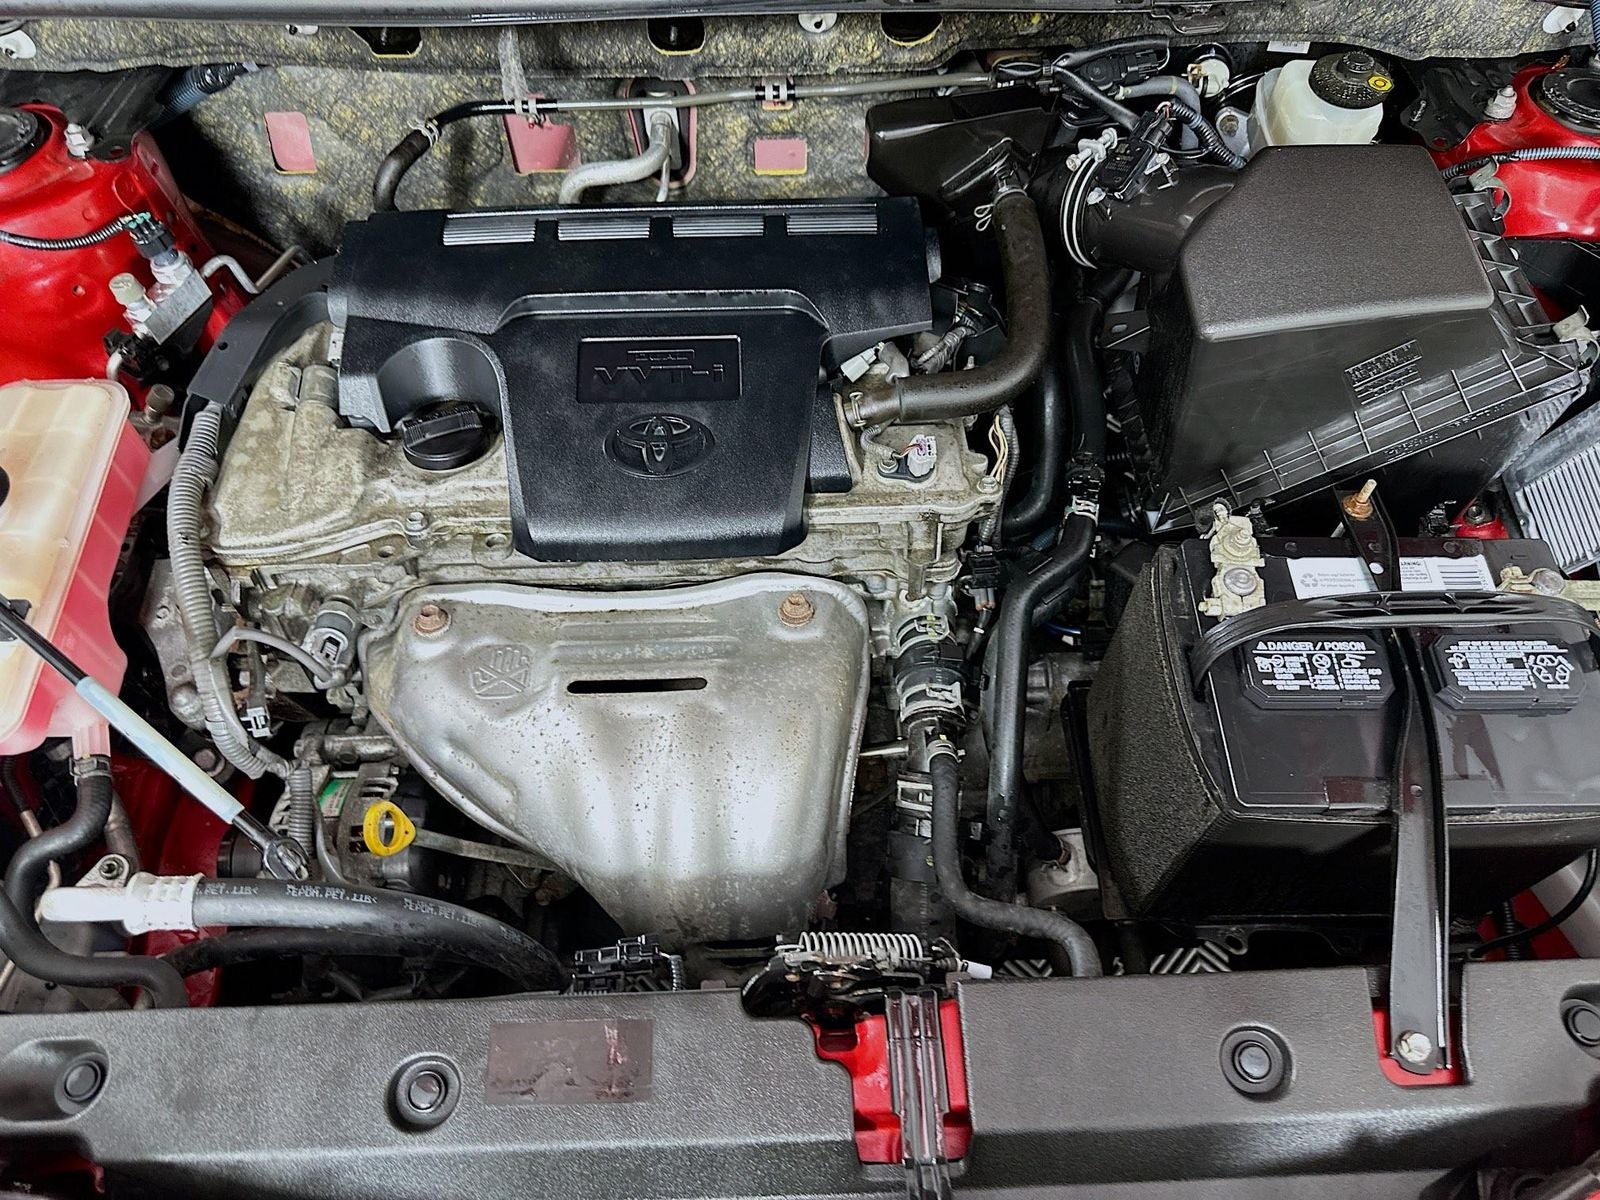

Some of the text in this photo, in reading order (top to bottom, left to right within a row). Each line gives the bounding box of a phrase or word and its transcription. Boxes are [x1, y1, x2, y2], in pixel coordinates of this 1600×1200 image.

[594, 364, 725, 384] VVT-i
[1267, 641, 1366, 651] DANGER / POISON
